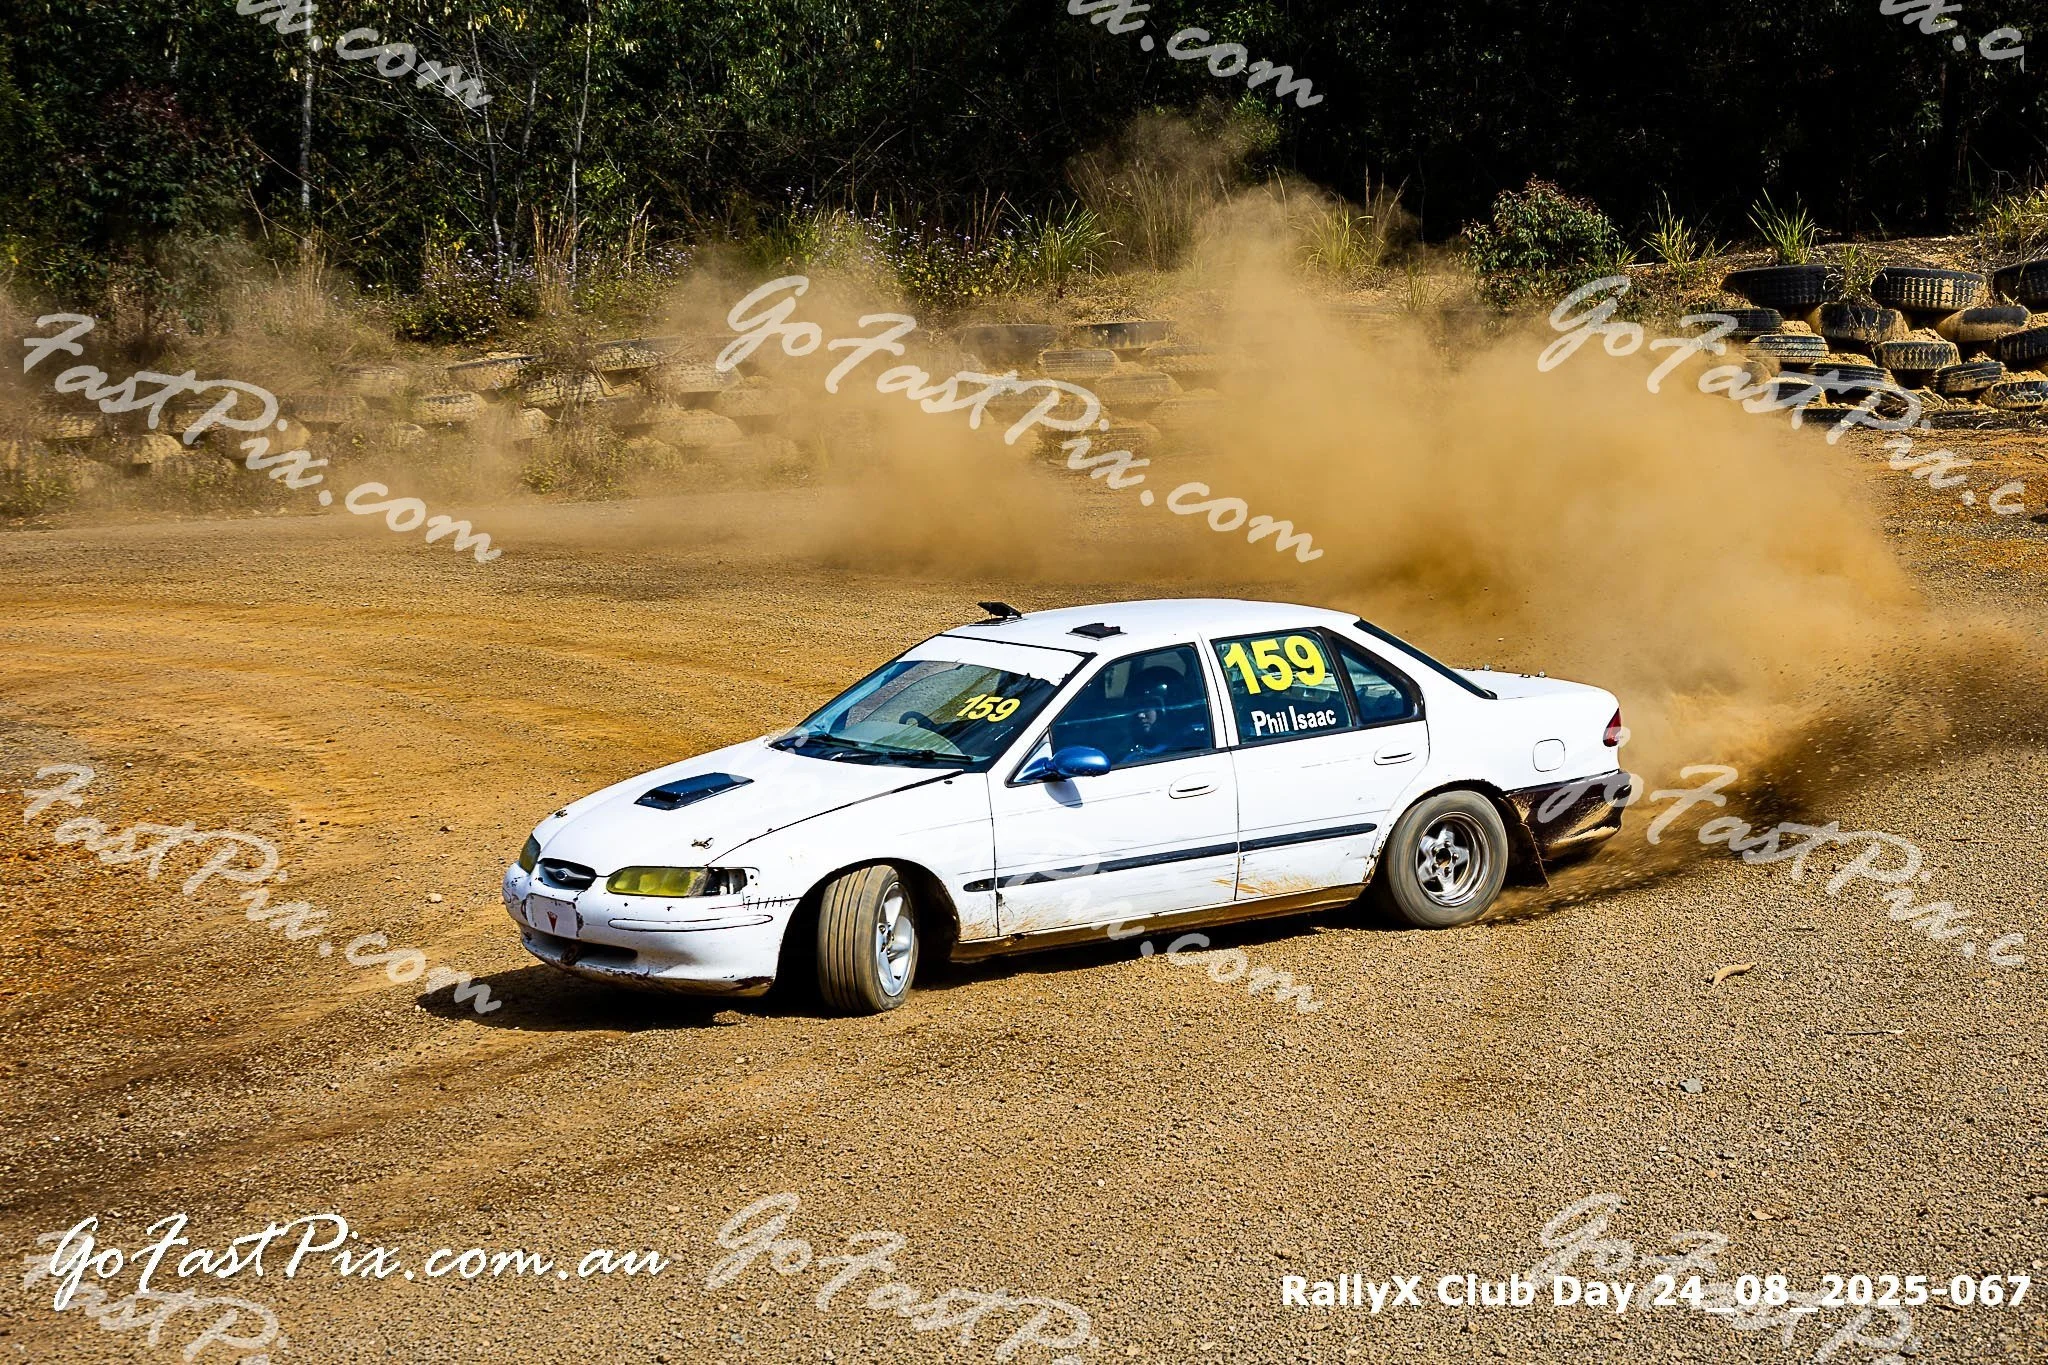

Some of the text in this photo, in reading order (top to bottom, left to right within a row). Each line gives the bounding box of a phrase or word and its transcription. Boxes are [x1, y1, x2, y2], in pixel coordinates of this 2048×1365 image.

[1224, 635, 1326, 695] 159
[956, 694, 1020, 722] 159
[1250, 705, 1337, 737] Phil Isaac
